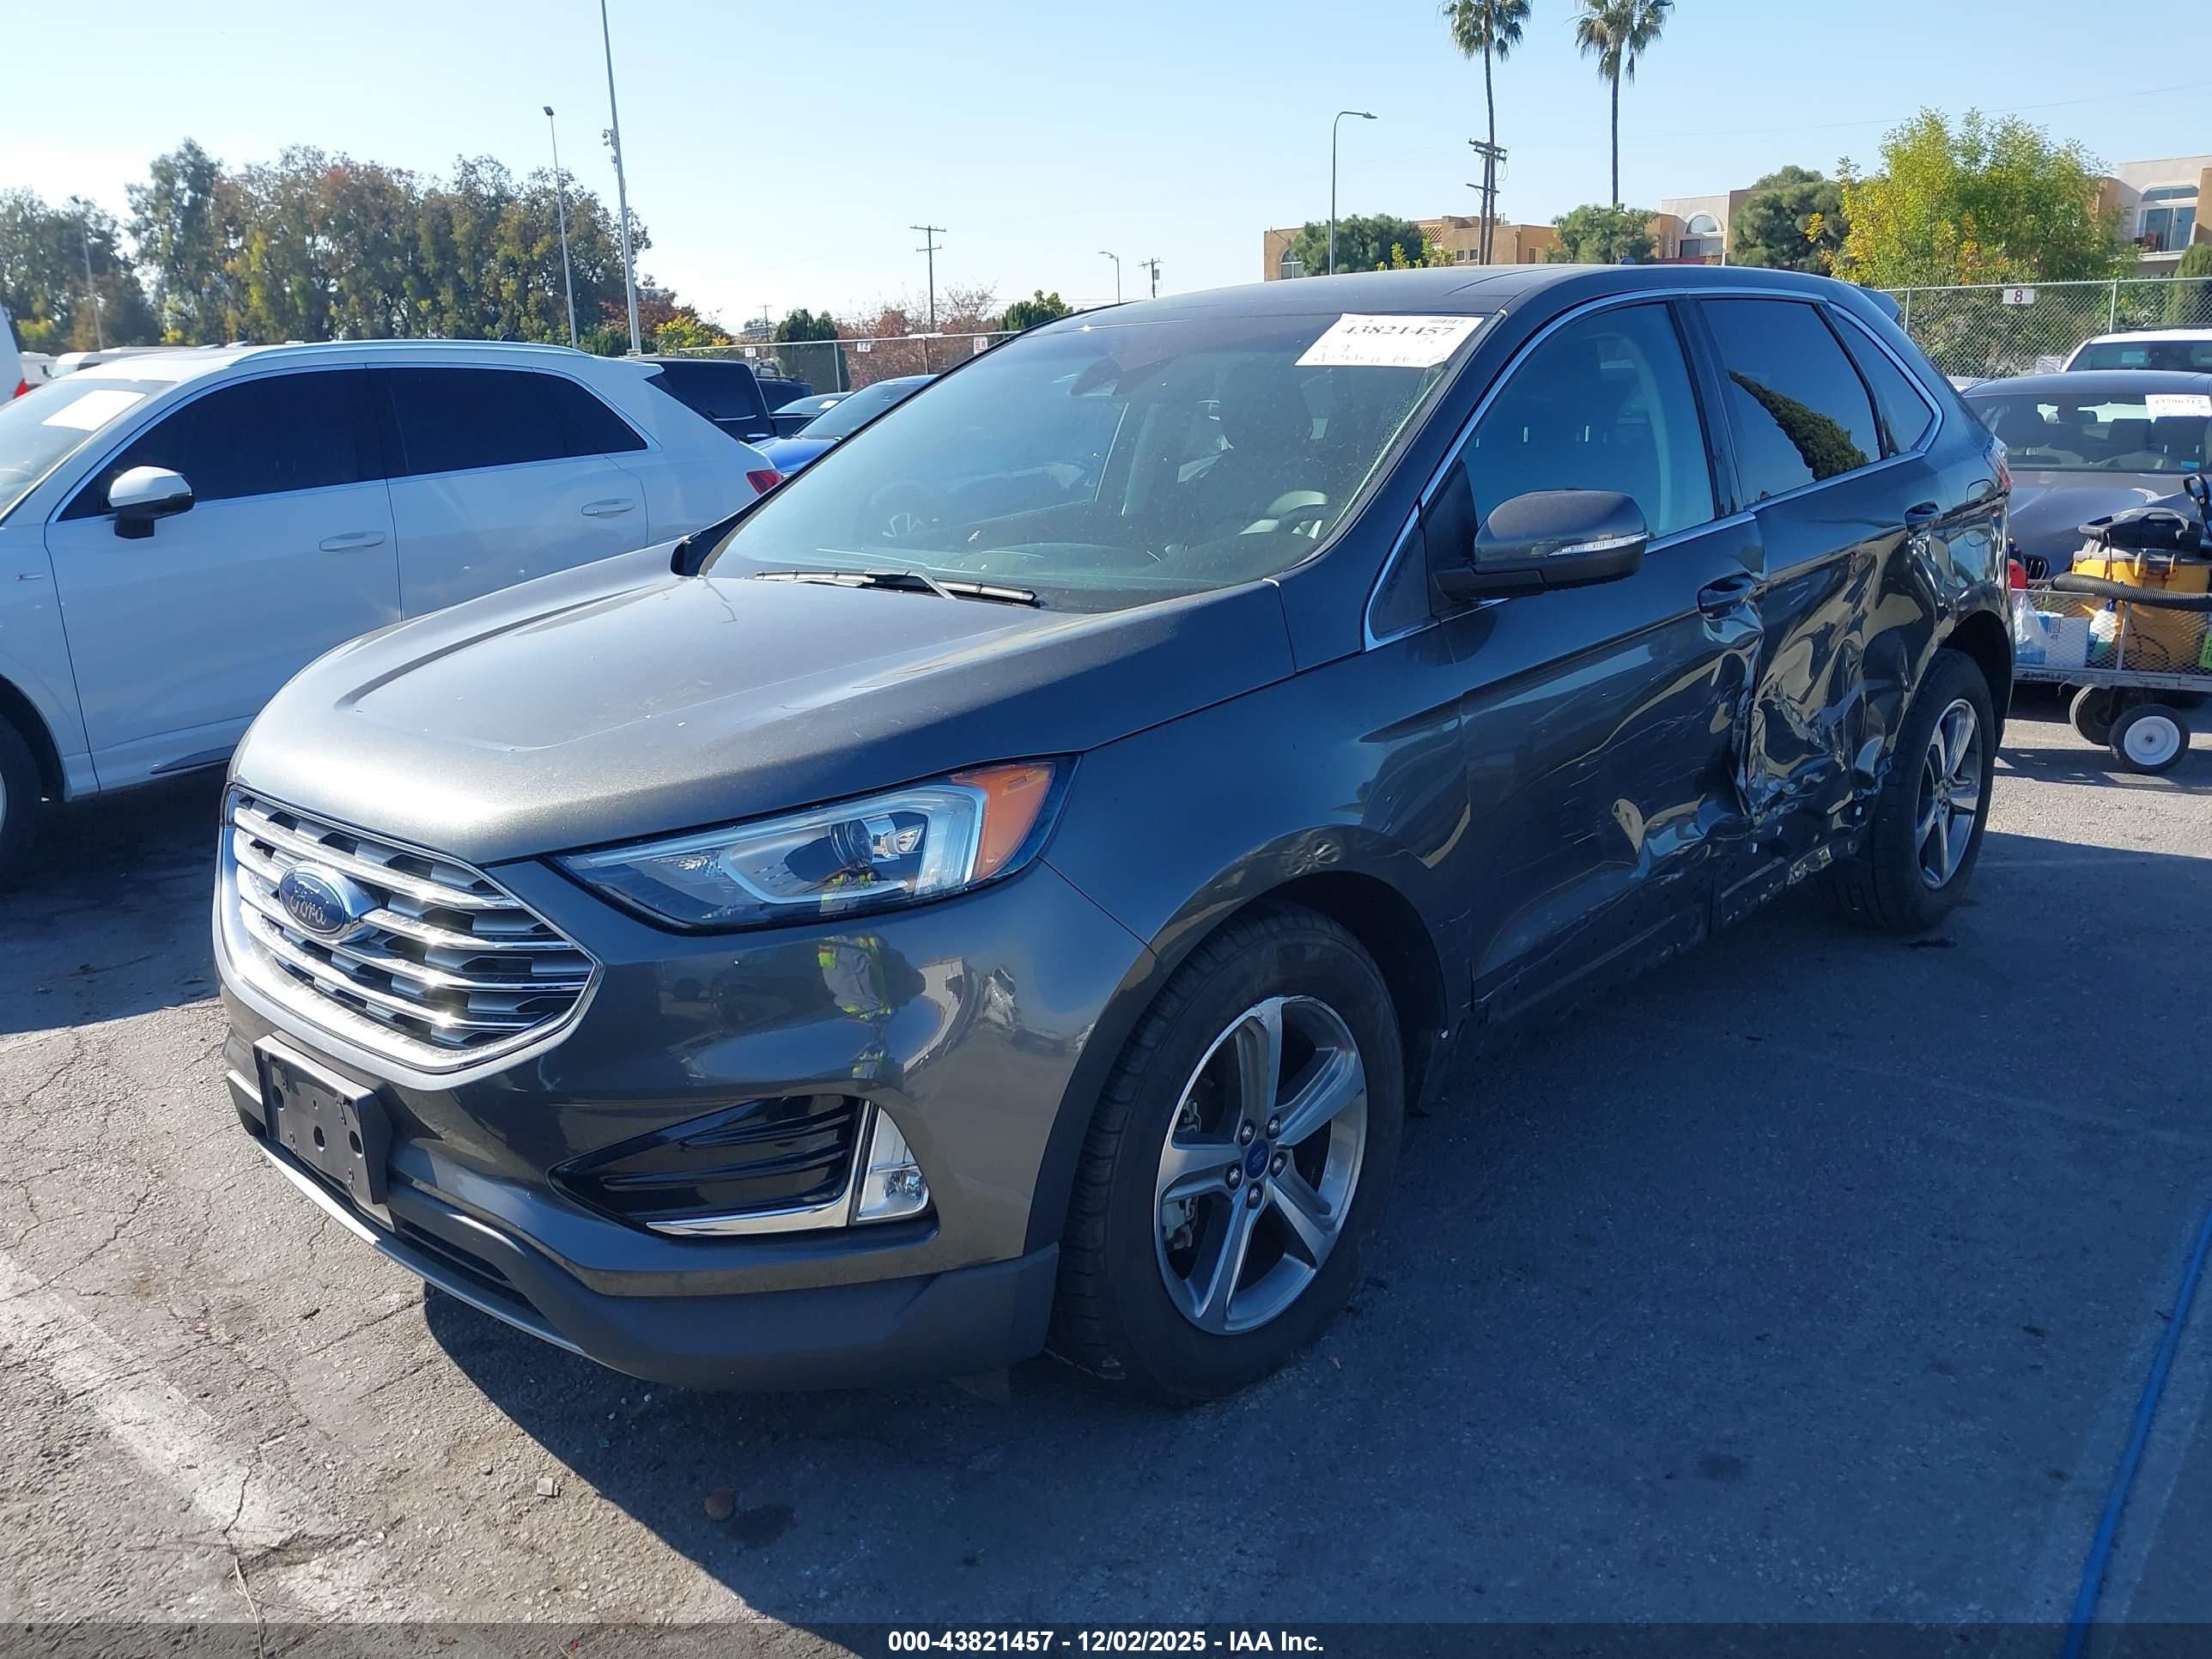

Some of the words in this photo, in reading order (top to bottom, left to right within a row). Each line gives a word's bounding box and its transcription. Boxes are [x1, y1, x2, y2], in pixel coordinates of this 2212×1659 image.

[2014, 289, 2023, 303] 8
[1340, 325, 1457, 337] 43821457
[289, 879, 330, 926] Ford
